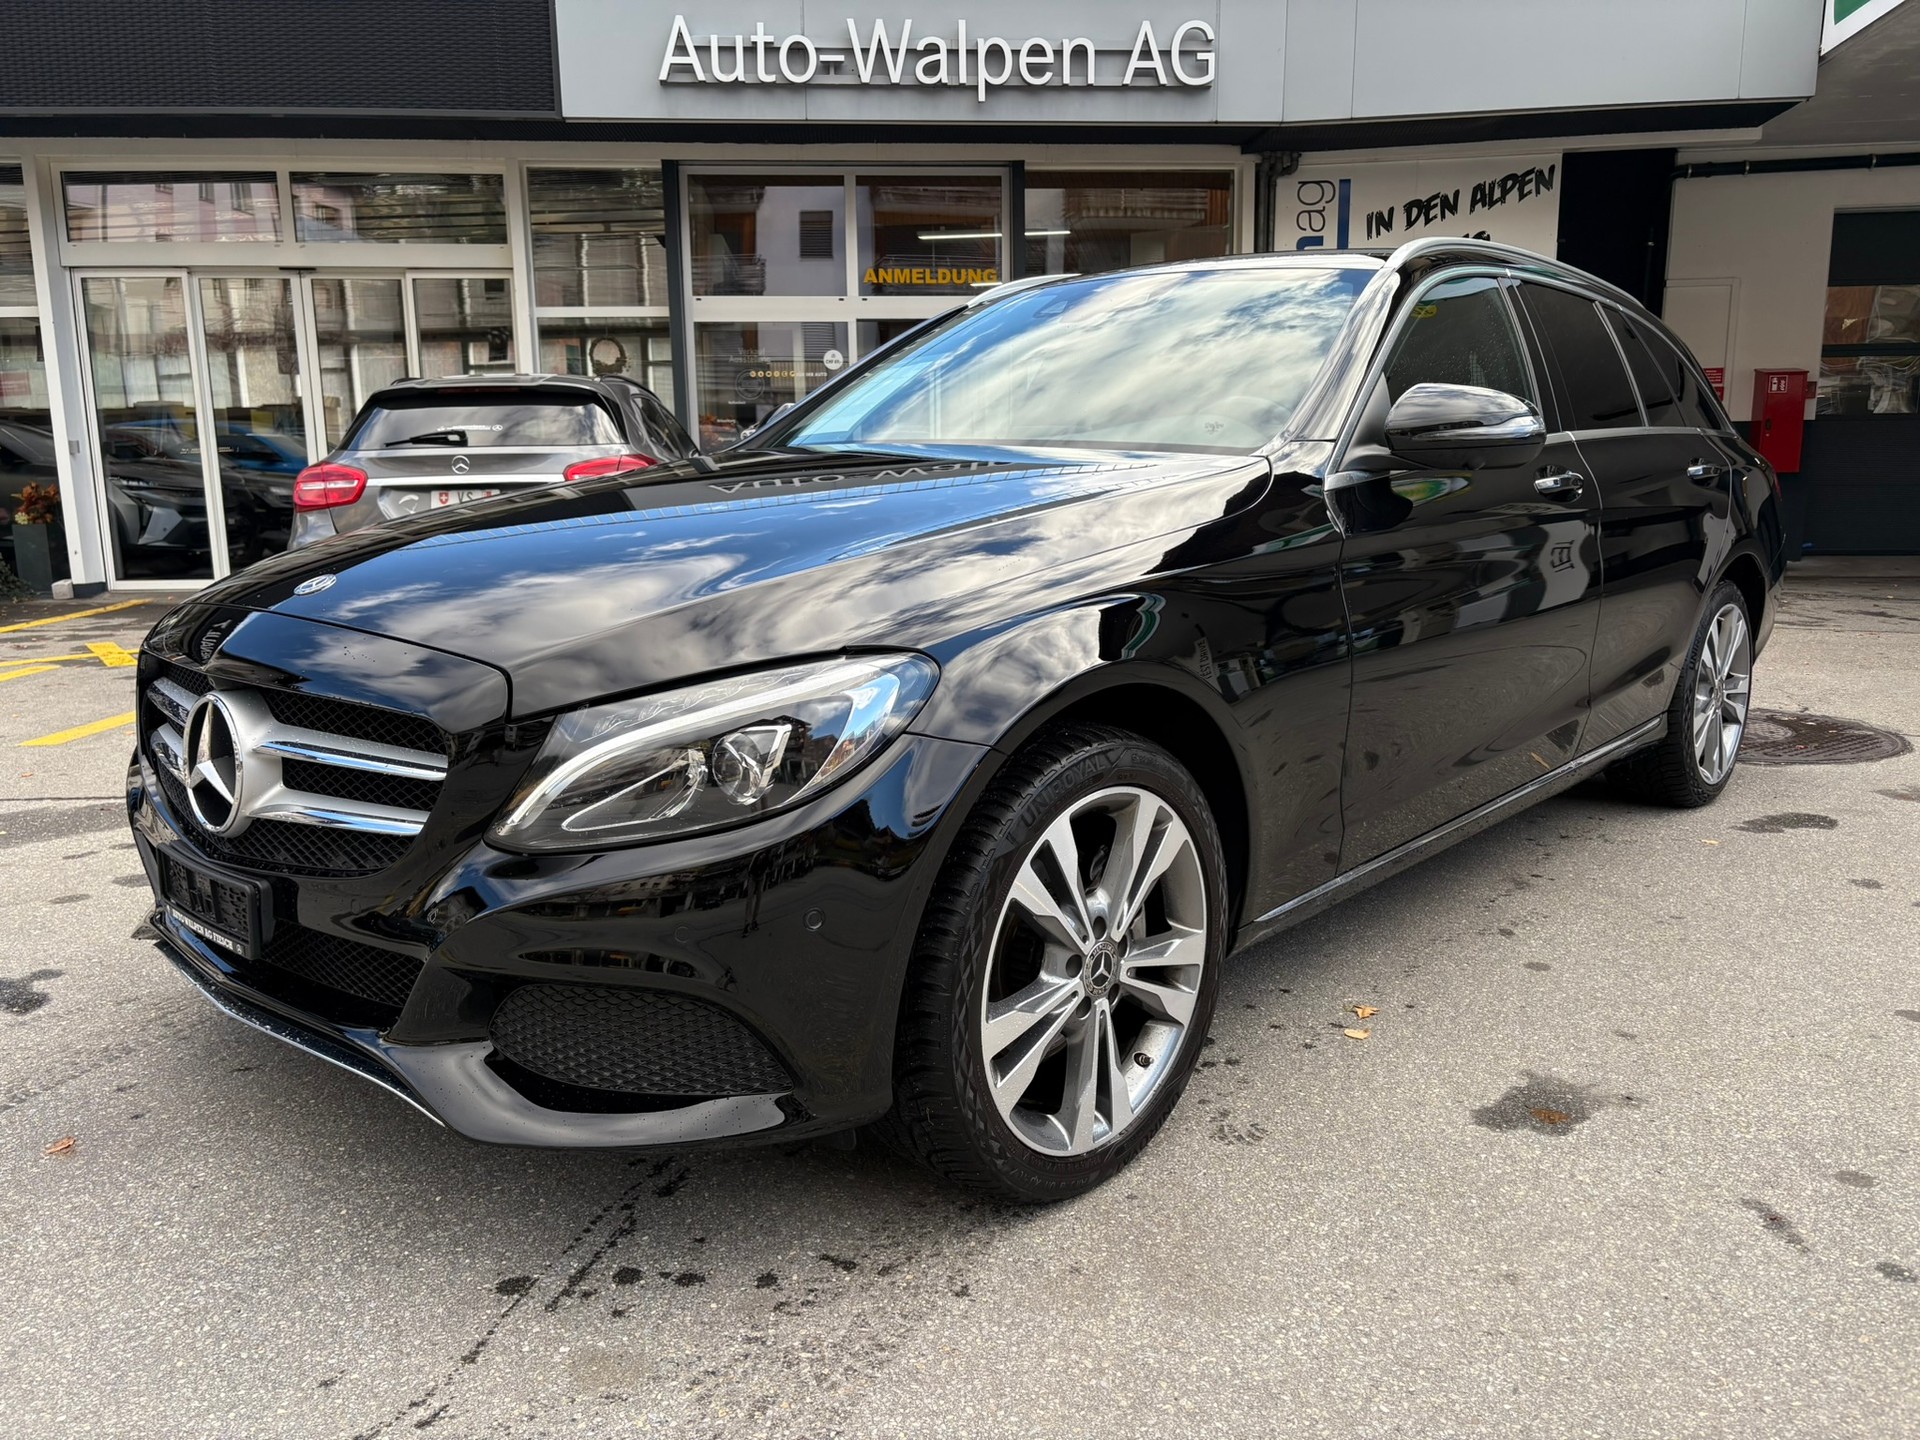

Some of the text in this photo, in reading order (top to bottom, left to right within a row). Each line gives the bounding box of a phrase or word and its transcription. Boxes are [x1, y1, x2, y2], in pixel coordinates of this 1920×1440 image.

[658, 14, 1217, 103] Auto-Walpen AG
[1366, 164, 1556, 241] IN DEN ALPEN
[863, 267, 998, 285] ANMELDUNG
